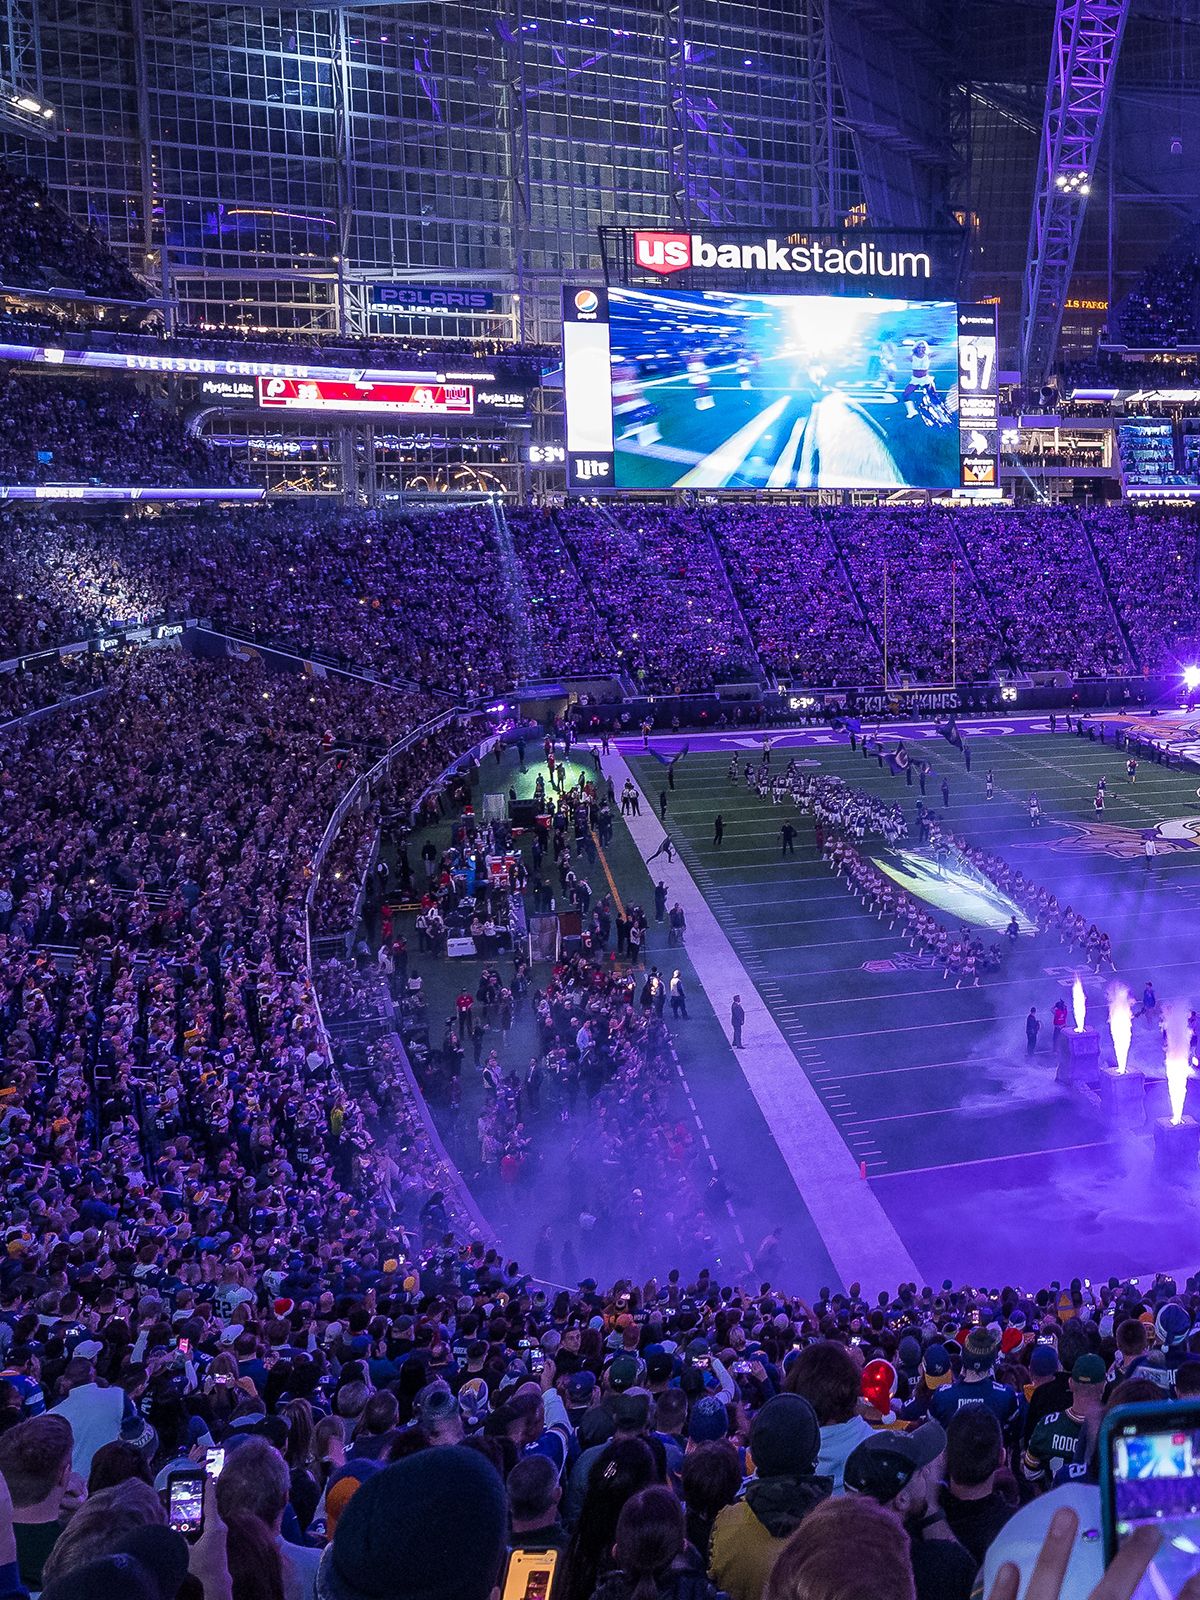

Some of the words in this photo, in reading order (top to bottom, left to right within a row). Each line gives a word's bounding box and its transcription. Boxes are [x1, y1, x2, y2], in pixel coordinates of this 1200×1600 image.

[381, 289, 487, 307] POLARIS
[126, 354, 216, 374] EVERSON
[225, 361, 309, 378] GRIFFEN
[959, 344, 994, 390] 97
[529, 446, 565, 462] 6:34
[575, 459, 610, 479] Lite
